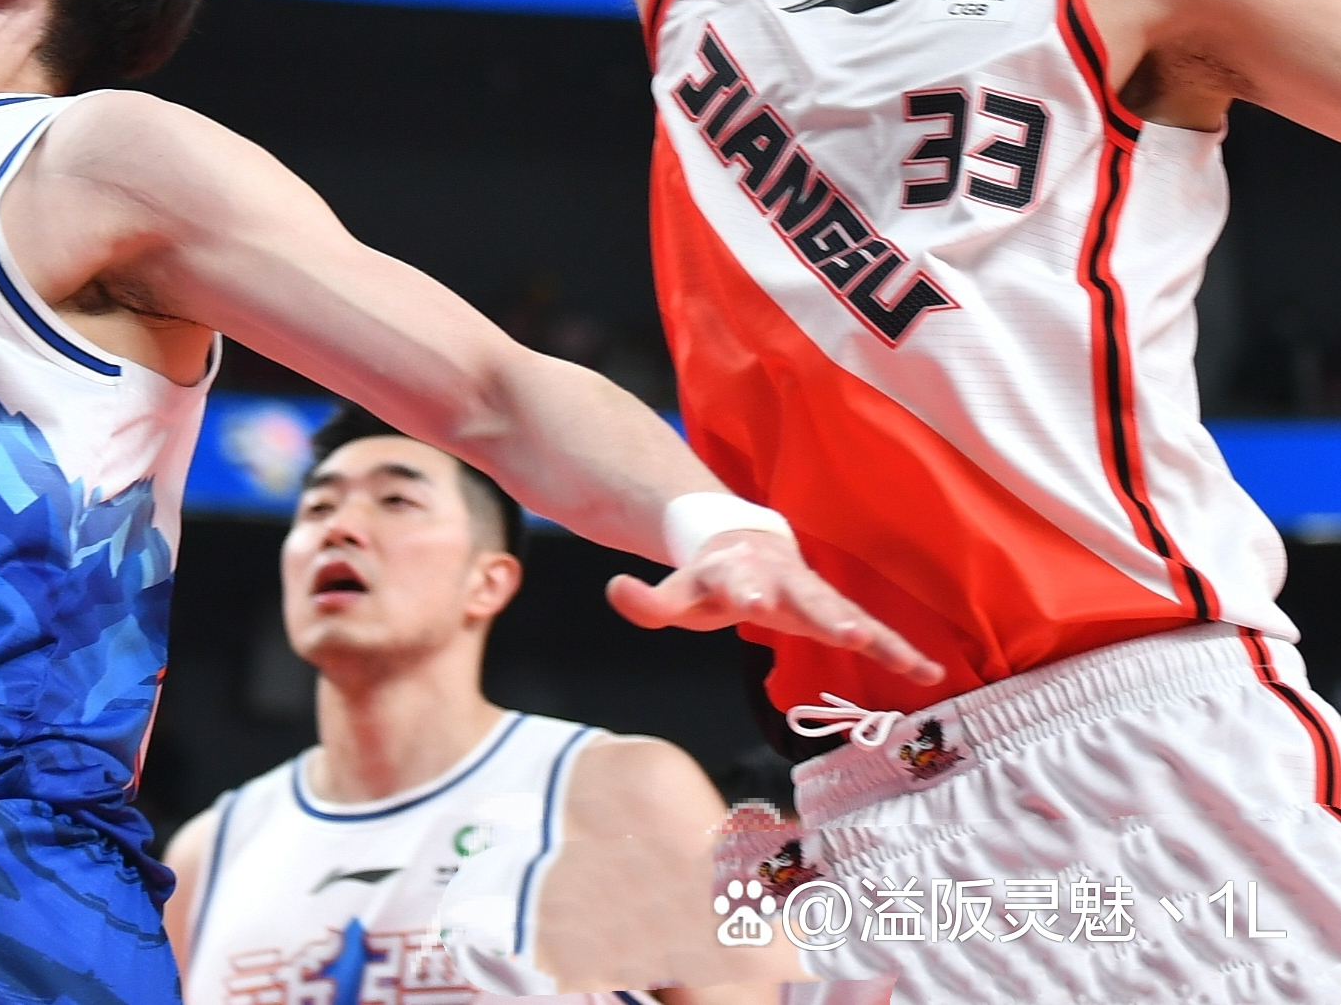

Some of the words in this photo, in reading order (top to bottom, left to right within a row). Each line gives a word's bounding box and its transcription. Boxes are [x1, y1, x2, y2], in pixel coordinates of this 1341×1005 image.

[947, 3, 989, 16] CGB
[671, 22, 962, 350] JIANGSU
[900, 86, 1052, 214] 33
